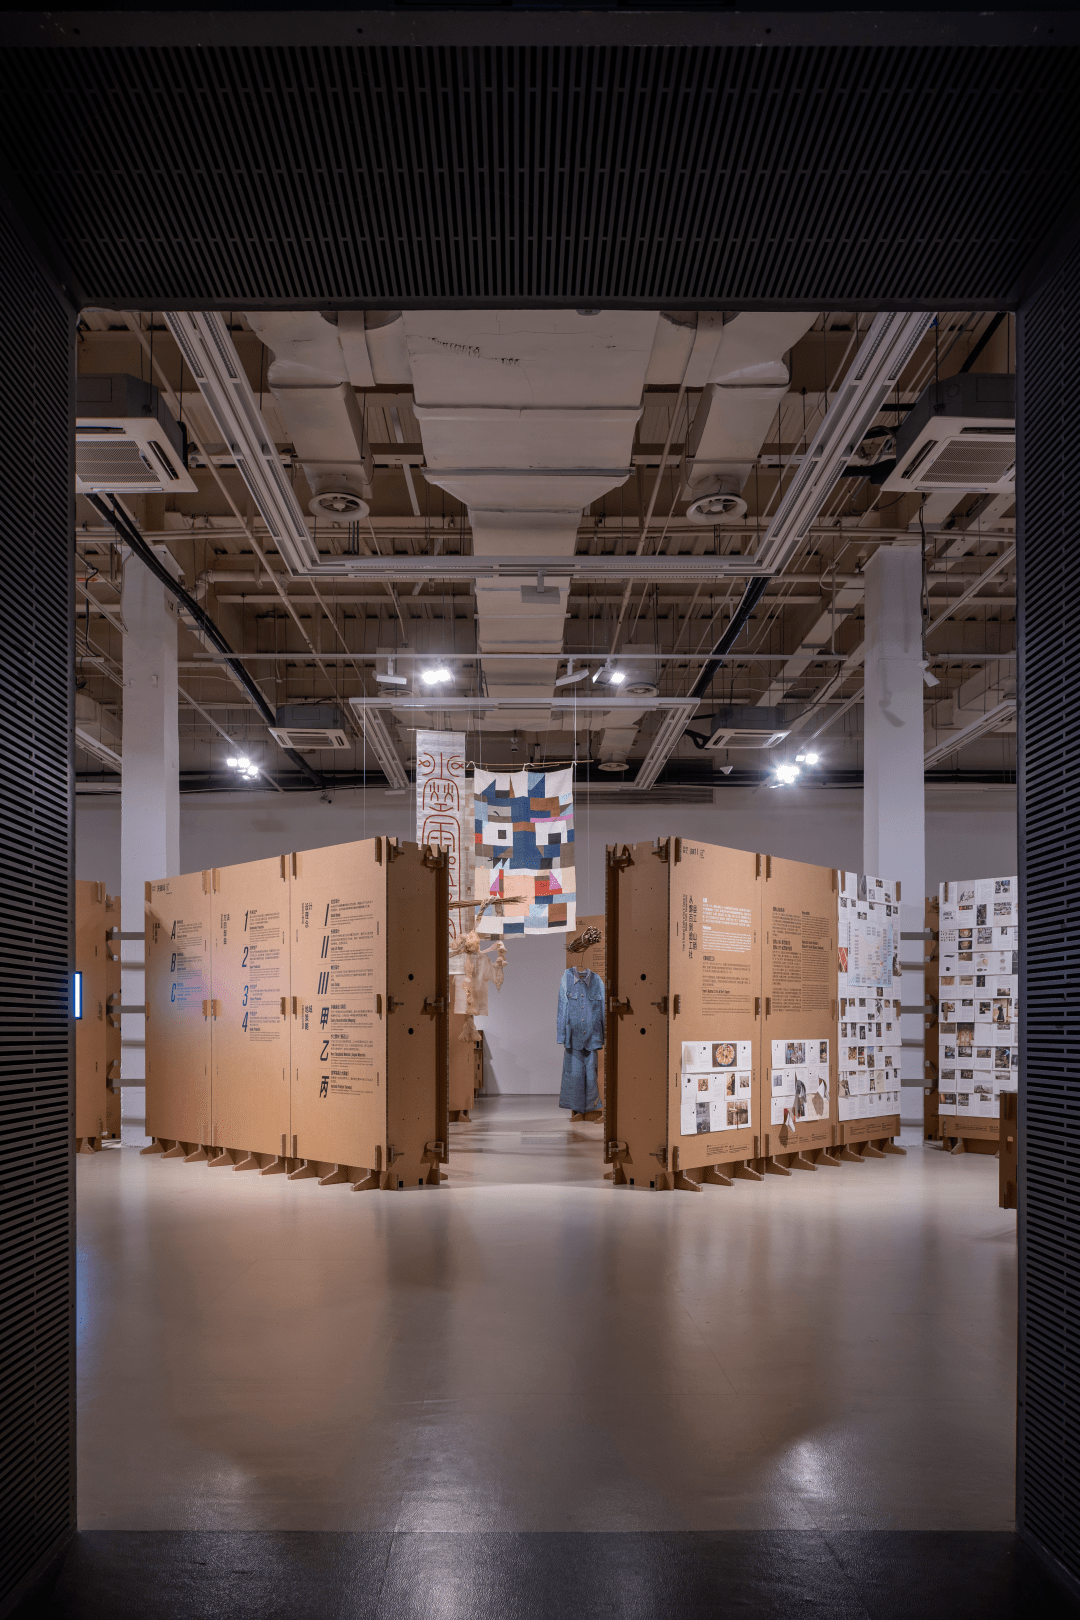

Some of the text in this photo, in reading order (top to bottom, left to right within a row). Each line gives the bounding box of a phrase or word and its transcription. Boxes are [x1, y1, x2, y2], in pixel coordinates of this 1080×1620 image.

[171, 921, 176, 940] A
[244, 910, 248, 931] 1
[171, 953, 176, 972] B
[242, 946, 249, 967] 2
[171, 983, 176, 1002] C
[242, 985, 249, 1006] 3
[242, 1012, 248, 1032] 4
[320, 1007, 329, 1030] 甲
[319, 1076, 329, 1098] 丙
